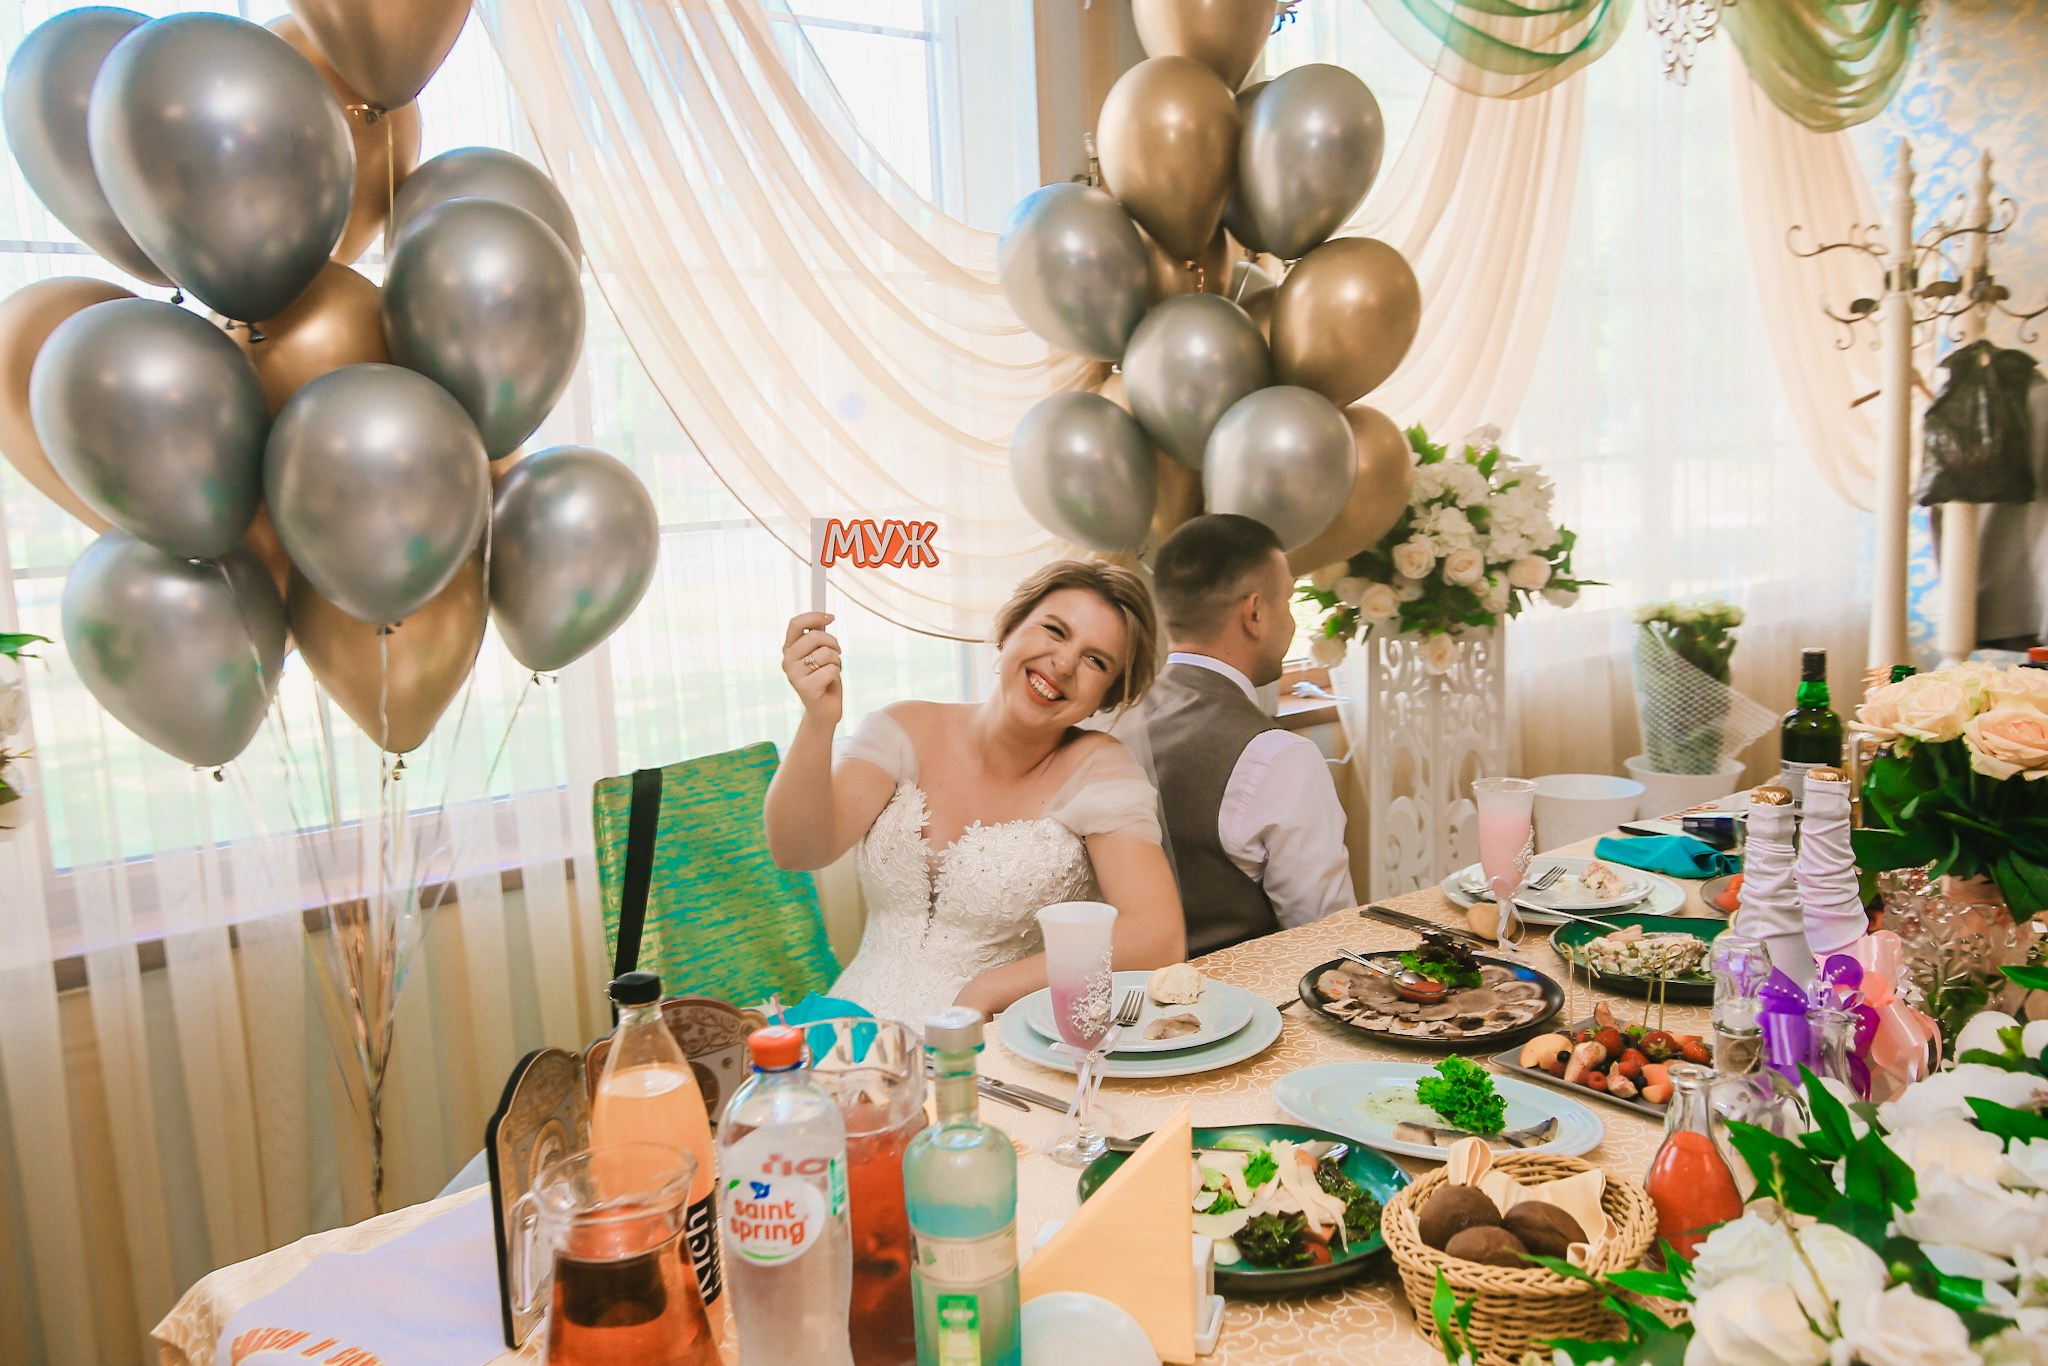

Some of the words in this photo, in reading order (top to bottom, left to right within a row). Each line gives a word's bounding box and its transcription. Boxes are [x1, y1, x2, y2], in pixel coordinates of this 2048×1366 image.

[821, 520, 939, 567] МУЖ
[734, 1199, 797, 1219] saint
[730, 1217, 806, 1245] spring
